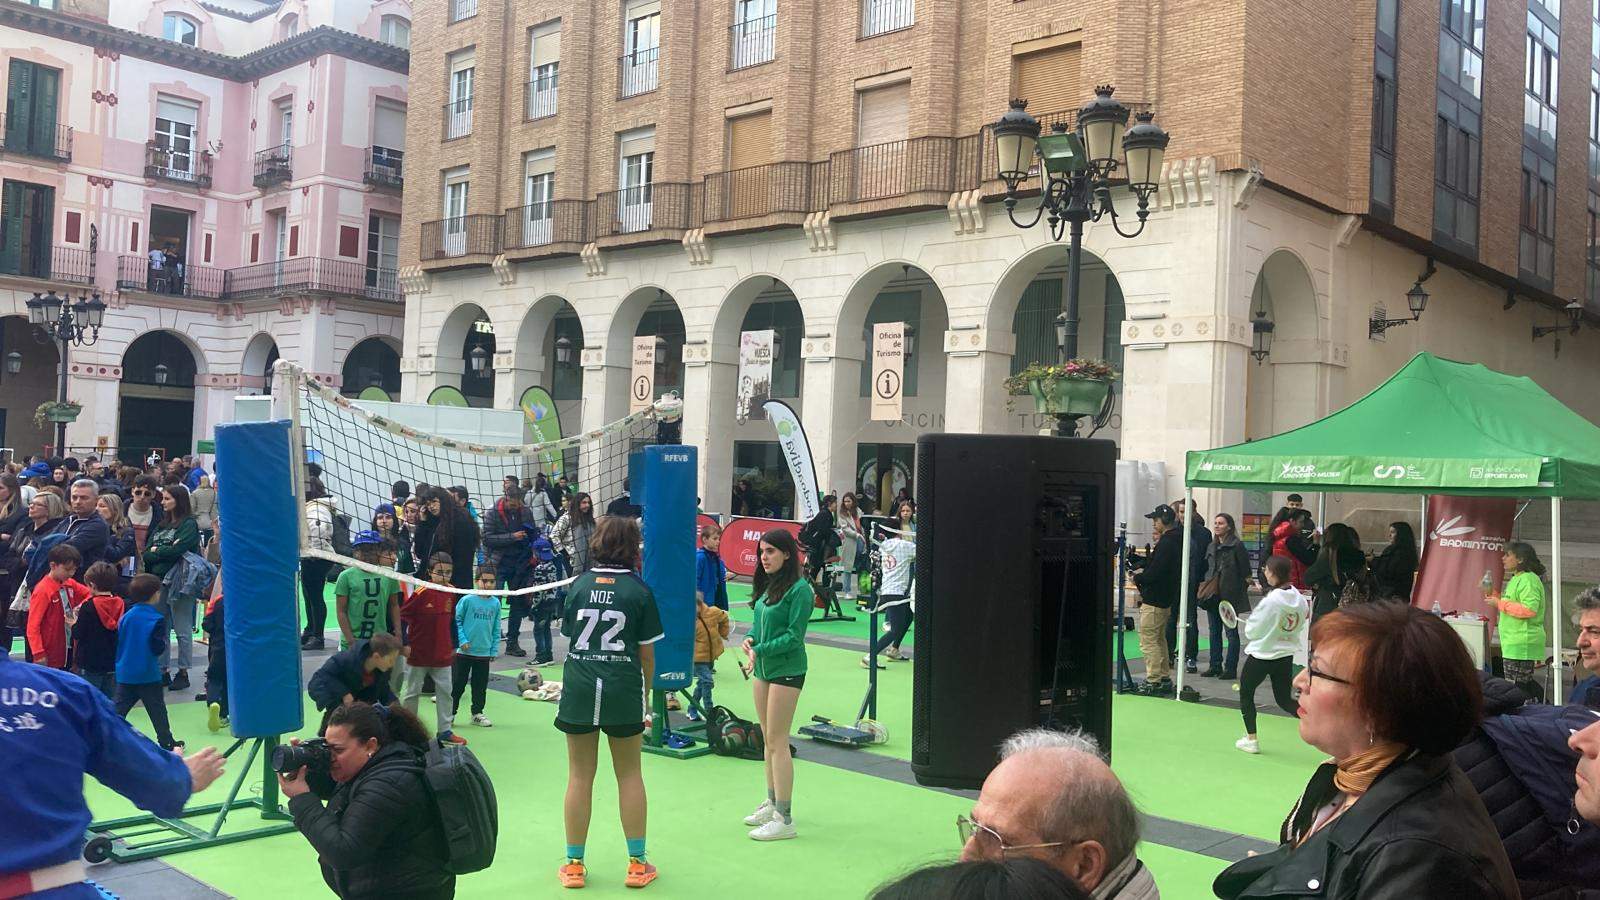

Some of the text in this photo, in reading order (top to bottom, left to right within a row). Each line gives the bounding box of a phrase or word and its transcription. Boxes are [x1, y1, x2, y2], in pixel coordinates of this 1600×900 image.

[878, 332, 902, 340] Oficina
[892, 340, 902, 348] de
[876, 349, 902, 357] Turismo
[664, 454, 689, 462] RFEVB
[1213, 463, 1252, 472] IBERDROLA
[589, 590, 615, 604] NOE
[574, 608, 627, 652] 72
[1, 687, 59, 709] UDO
